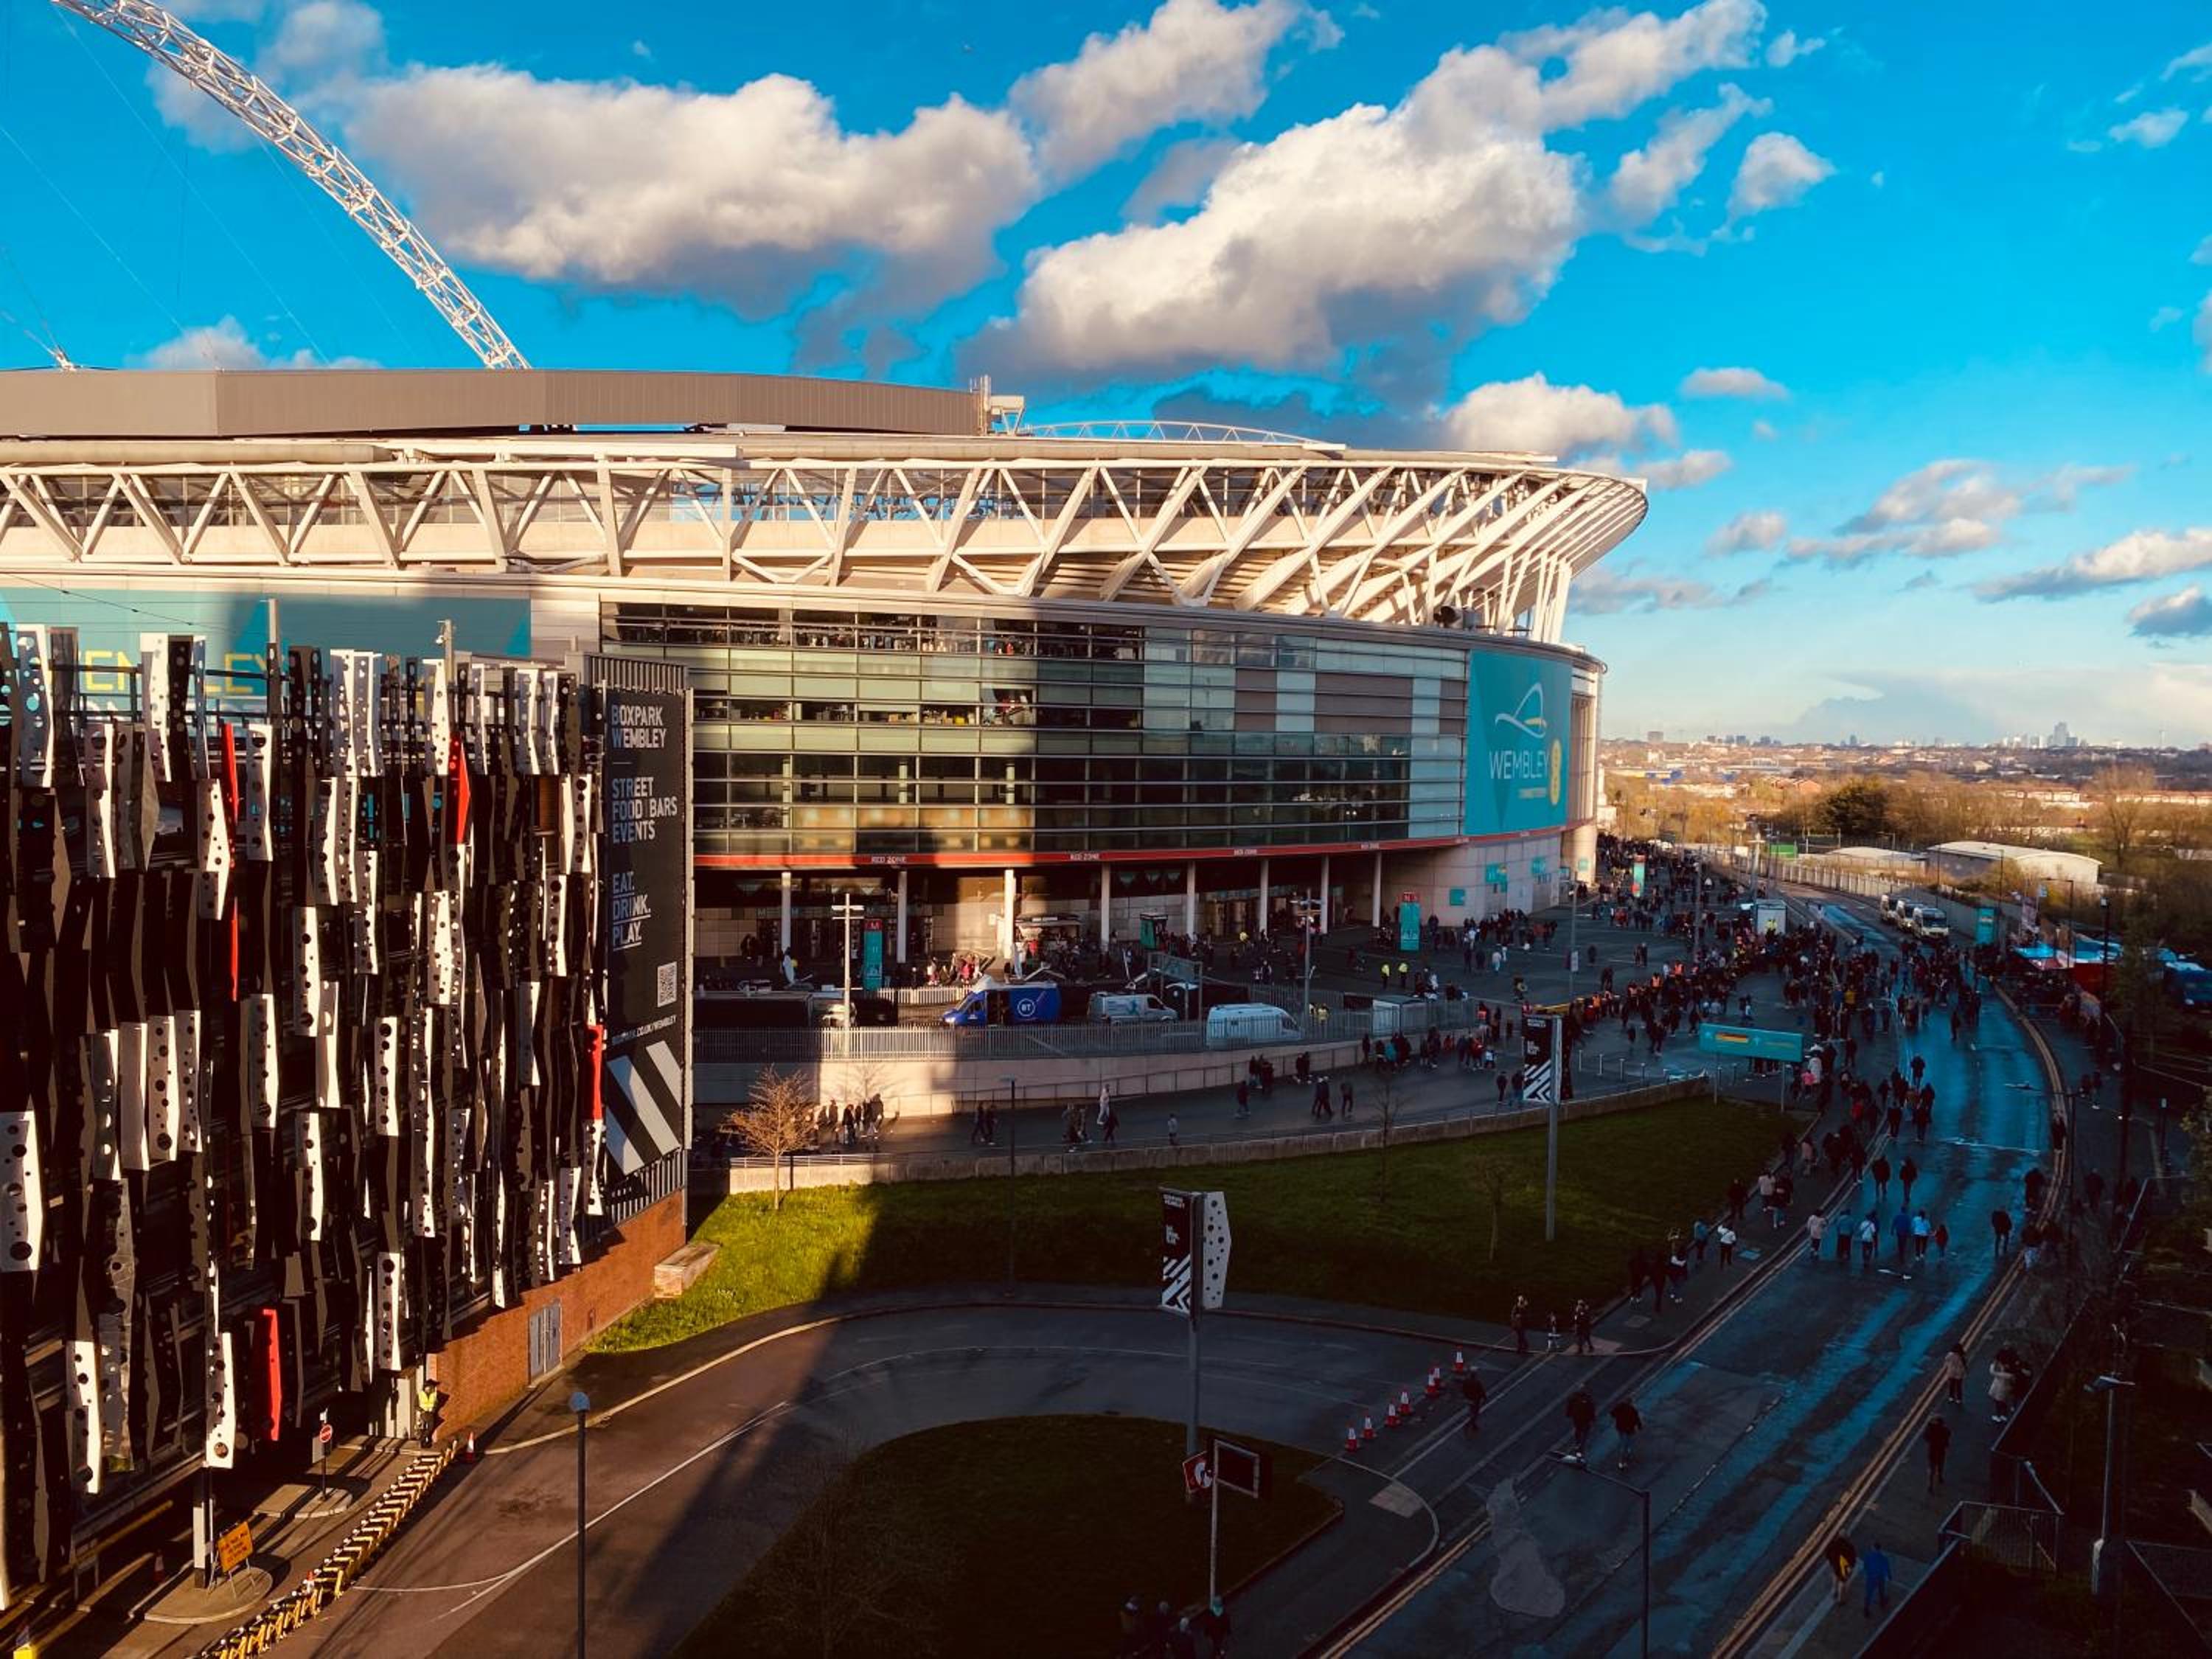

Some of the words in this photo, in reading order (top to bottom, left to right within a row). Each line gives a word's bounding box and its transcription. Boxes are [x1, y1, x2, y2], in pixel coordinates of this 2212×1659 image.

[611, 704, 663, 726] BOXPARK
[612, 728, 667, 749] WEMBLEY
[1489, 749, 1550, 779] WEMBLEY
[612, 776, 655, 799] STREET
[613, 799, 643, 821] FOOD
[650, 796, 678, 818] BARS
[613, 820, 655, 844] EVENTS
[871, 855, 886, 863] RED
[886, 855, 908, 863] ZONE
[613, 871, 635, 894] EAT.
[613, 894, 651, 919] DRINK.
[613, 921, 641, 946] PLAY.
[1021, 1004, 1031, 1012] BT
